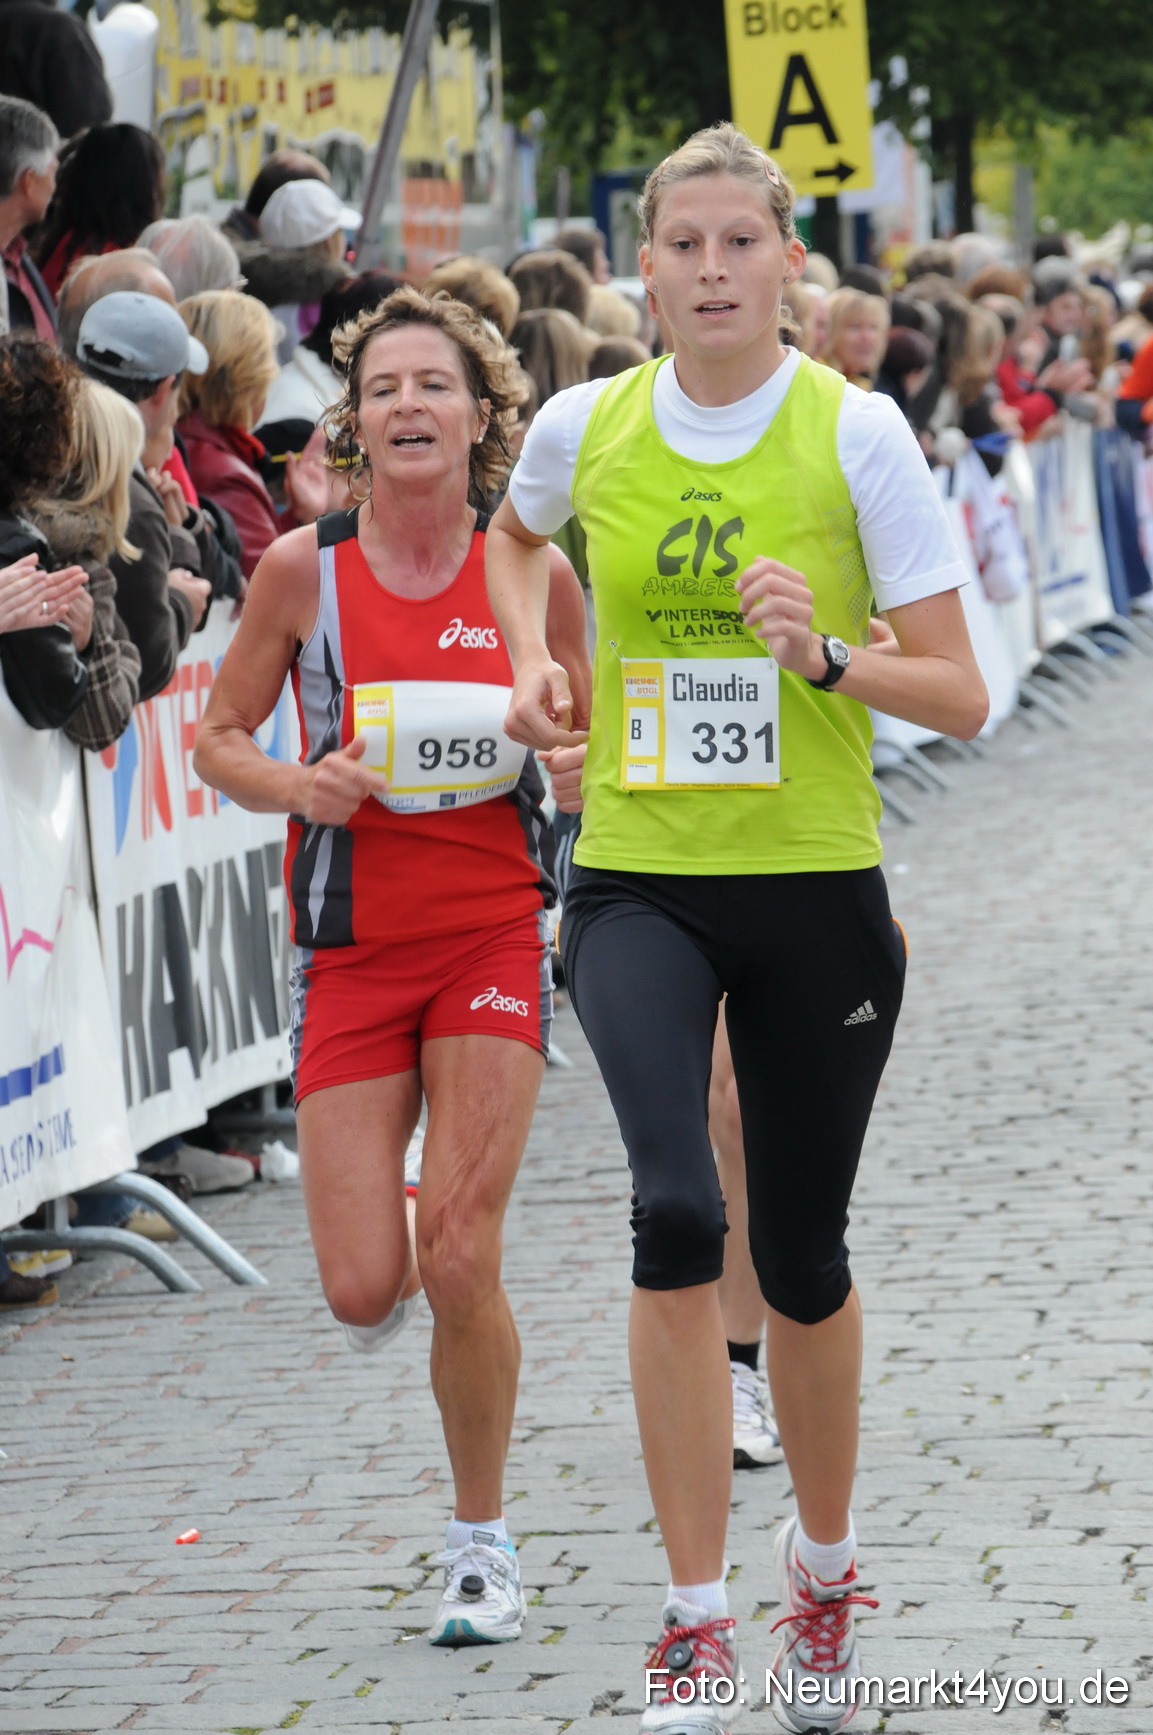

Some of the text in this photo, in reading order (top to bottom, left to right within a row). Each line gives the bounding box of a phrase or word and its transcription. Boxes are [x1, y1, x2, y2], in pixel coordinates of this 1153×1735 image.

[744, 0, 847, 36] Block
[769, 52, 840, 150] A
[656, 514, 745, 578] CIS
[642, 576, 743, 598] AMBER
[670, 623, 744, 638] LANGE
[672, 673, 759, 702] Claudia
[631, 718, 642, 740] B
[691, 721, 774, 764] 331
[417, 737, 498, 771] 958
[843, 1012, 878, 1026] adidas
